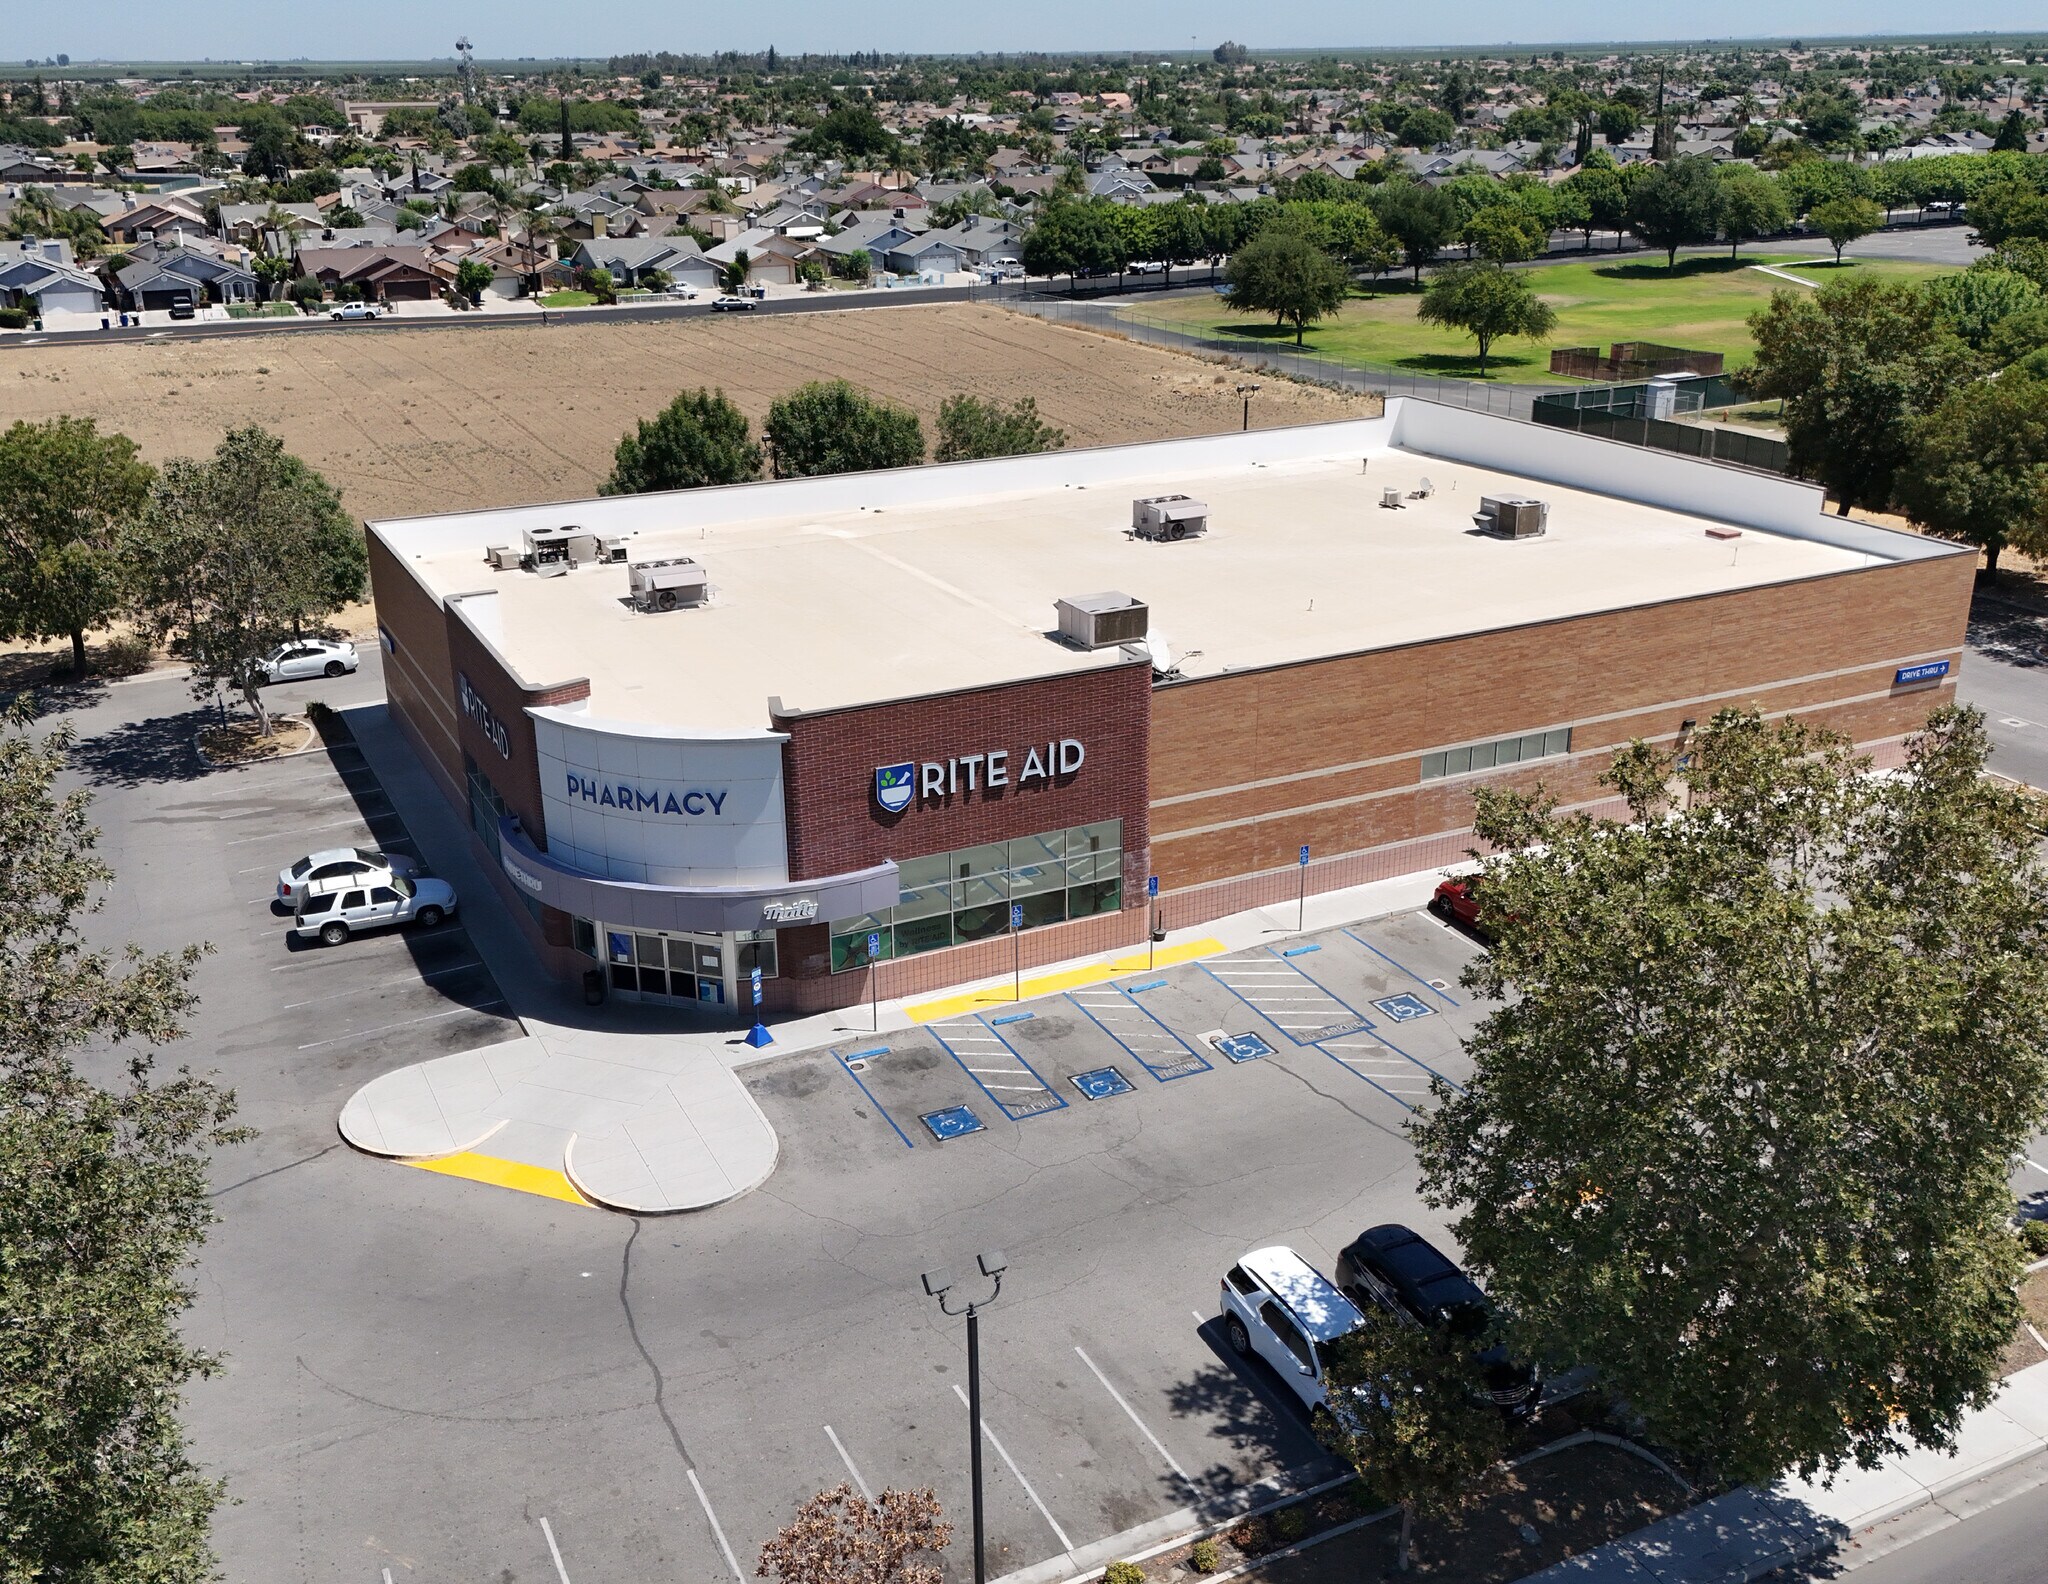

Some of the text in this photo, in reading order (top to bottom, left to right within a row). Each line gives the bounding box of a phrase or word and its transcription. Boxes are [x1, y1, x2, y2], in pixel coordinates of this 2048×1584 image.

[1901, 666, 1939, 680] DRIVE THRU
[467, 686, 509, 760] RITE AID
[921, 738, 1085, 798] RITE AID
[567, 774, 727, 816] PHARMACY
[763, 899, 819, 922] Thrifty
[901, 923, 942, 937] Wellness
